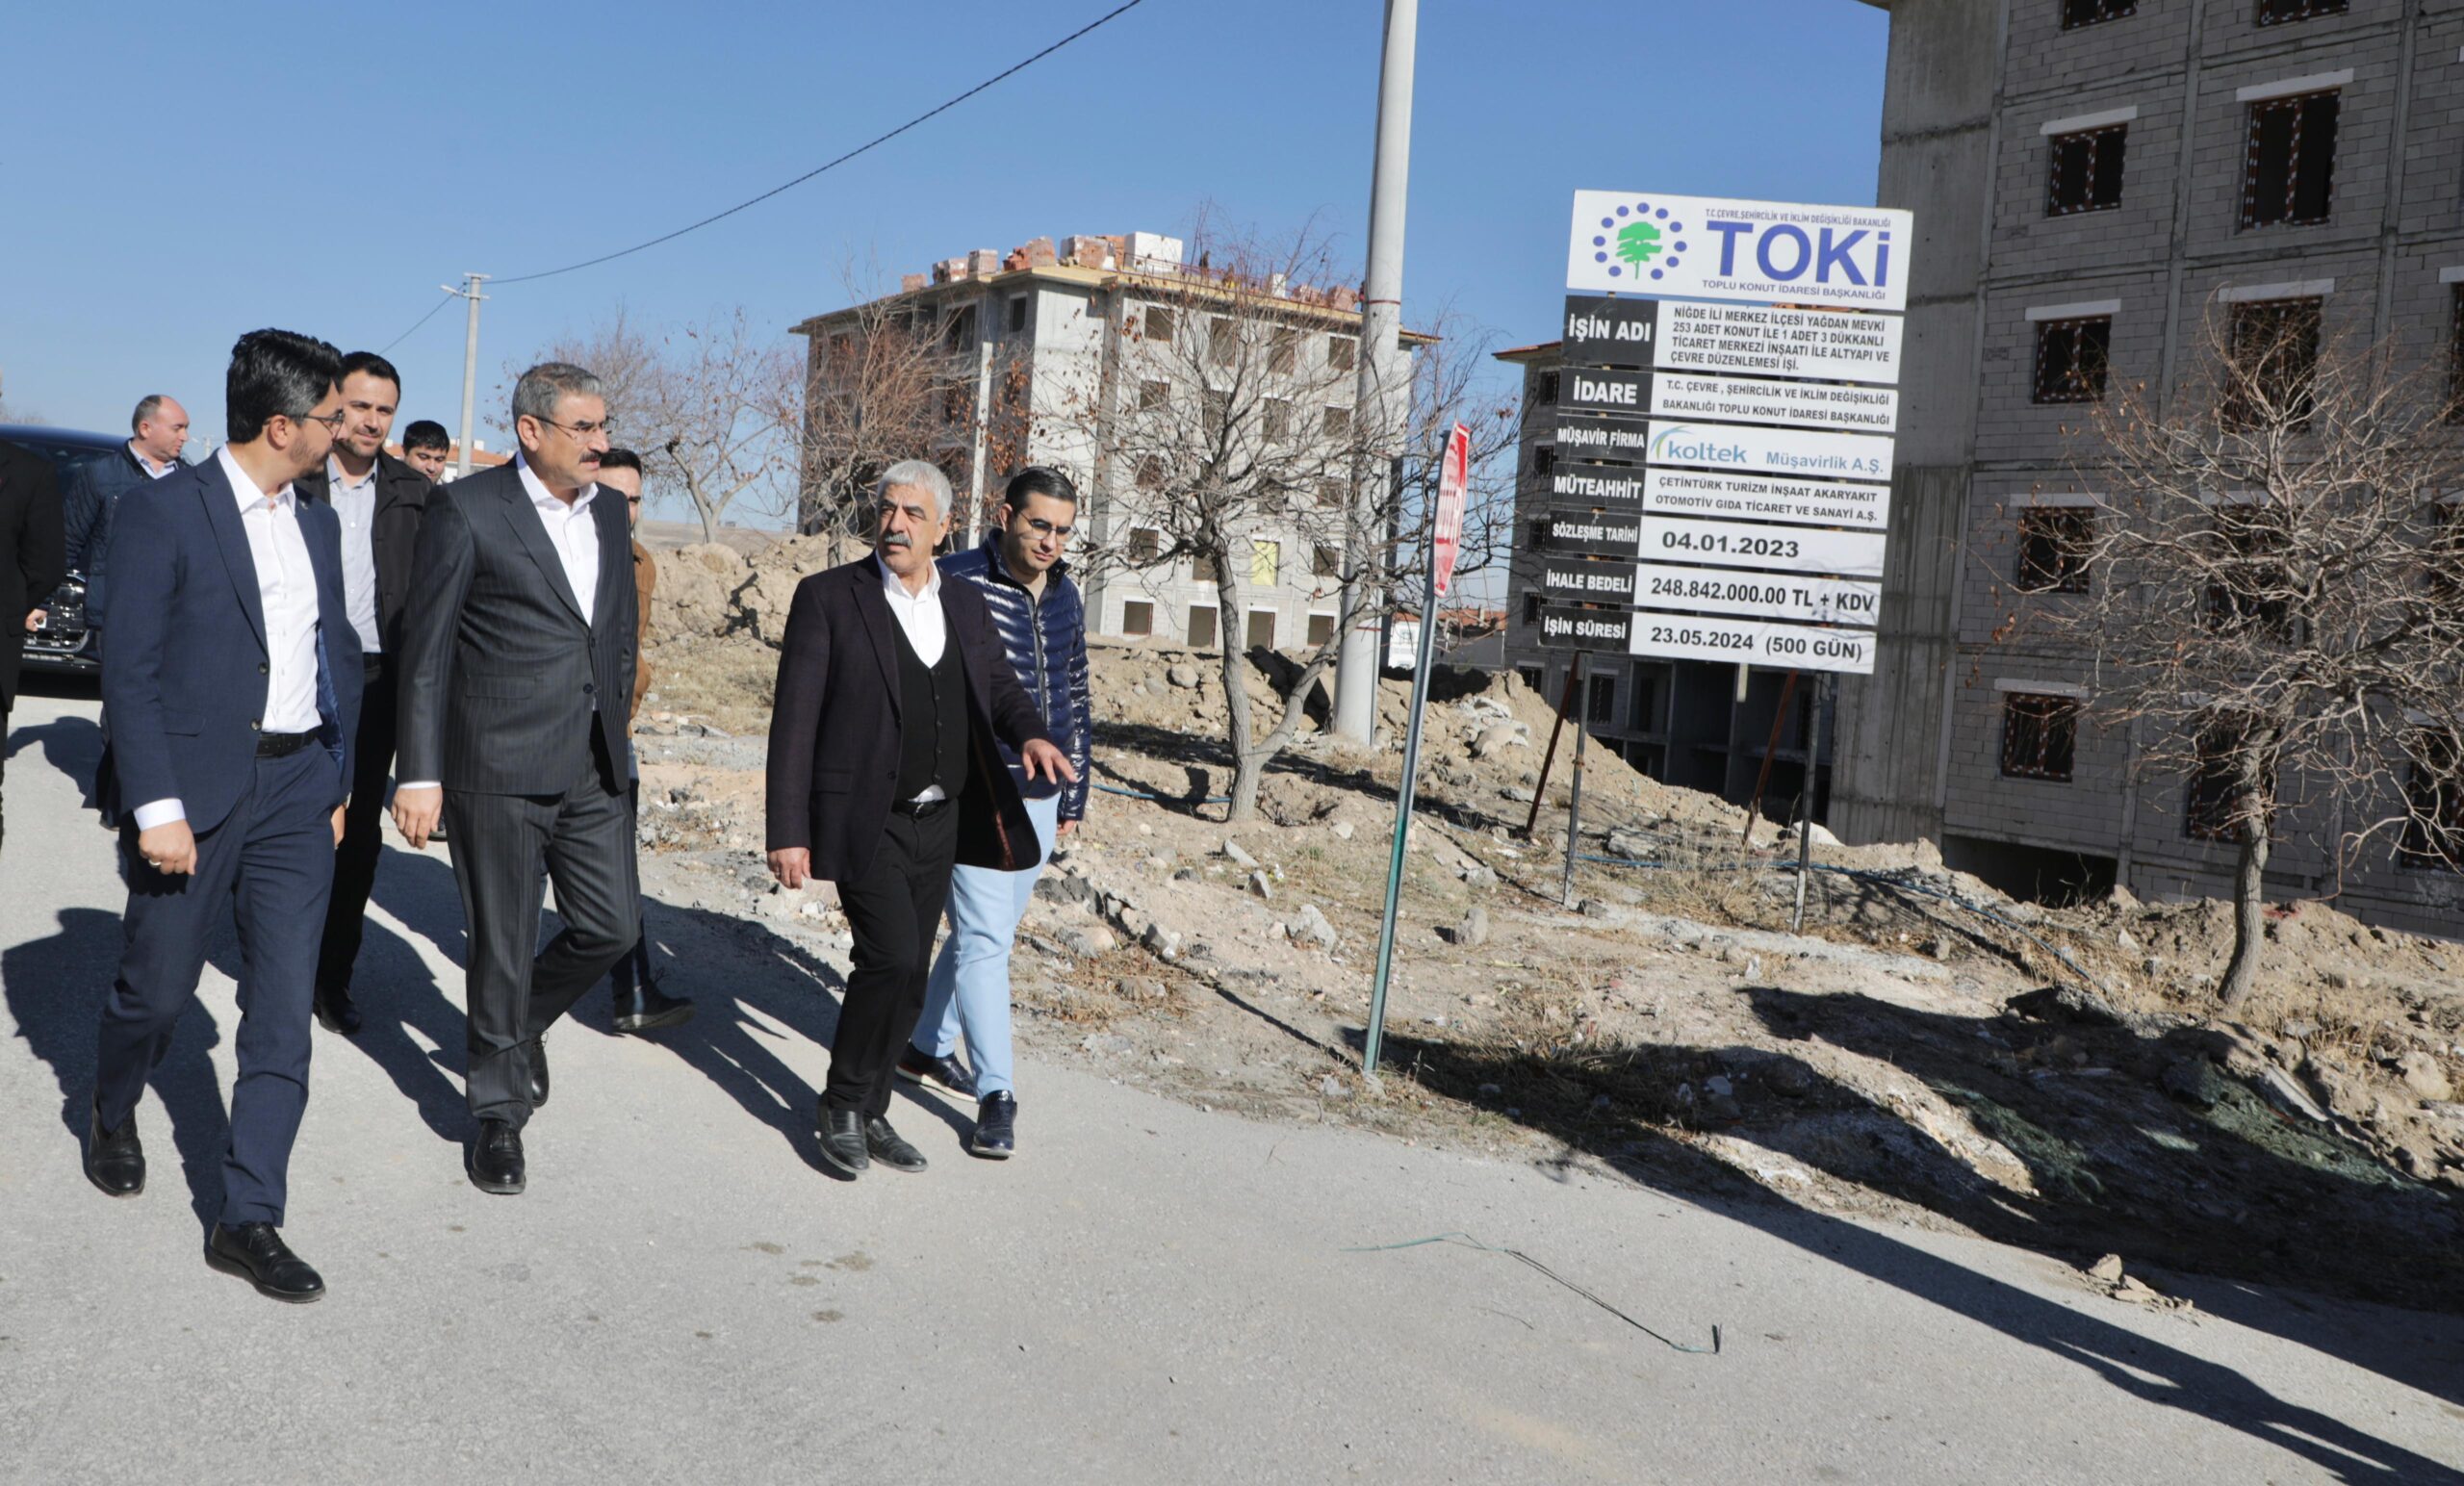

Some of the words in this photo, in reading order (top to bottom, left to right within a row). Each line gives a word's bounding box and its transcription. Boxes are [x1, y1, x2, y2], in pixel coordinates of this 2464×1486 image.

[1780, 213, 1789, 221] VE
[1790, 211, 1810, 222] İKLİM
[1853, 217, 1891, 227] BAKANLIĞI
[1702, 279, 1736, 289] TOPLU
[1739, 282, 1776, 293] KONUT
[1779, 283, 1820, 295] İDARESİ
[1822, 288, 1886, 300] BAŞKANLIĞI
[1569, 313, 1610, 343] İŞİN
[1615, 320, 1651, 342] ADI
[1674, 305, 1707, 320] NİĞDE
[1708, 307, 1722, 320] İLİ
[1725, 310, 1768, 323] MERKEZ
[1770, 311, 1804, 326] İLÇESİ
[1807, 315, 1849, 329] YAĞDAN
[1851, 318, 1886, 332] MEVKİ
[1673, 321, 1691, 333] 253
[1693, 322, 1721, 335] ADET
[1724, 325, 1760, 338] KONUT
[1762, 324, 1779, 340] İLE
[1783, 329, 1787, 340] 1
[1790, 330, 1818, 343] ADET
[1821, 332, 1827, 343] 3
[1830, 331, 1885, 346] DÜKKANLI
[1671, 350, 1705, 364] ÇEVRE
[1707, 351, 1780, 370] DÜZENLEMESİ
[1783, 356, 1799, 372] İŞİ.
[1672, 334, 1715, 349] TİCARET
[1718, 339, 1764, 353] MERKEZİ
[1767, 341, 1809, 357] İNŞAATI
[1810, 343, 1828, 358] İLE
[1830, 347, 1872, 361] ALTYAPI
[1875, 350, 1890, 362] VE
[1573, 375, 1637, 404] İDARE
[1667, 380, 1683, 391] T.C.
[1686, 381, 1718, 393] ÇEVRE
[1727, 383, 1782, 397] ŞEHİRCİLİK
[1784, 388, 1797, 398] VE
[1800, 387, 1828, 400] İKLİM
[1830, 391, 1889, 406] DEĞİŞİKLİĞİ
[1663, 399, 1715, 412] BAKANLIĞI
[1718, 403, 1750, 415] TOPLU
[1752, 405, 1786, 417] KONUT
[1789, 406, 1828, 421] İDARESİ
[1830, 411, 1889, 425] BAŞKANLIĞI
[1557, 425, 1607, 448] MÜŞAVİR
[1609, 428, 1645, 448] FİRMA
[1668, 440, 1748, 463] koltek
[1766, 450, 1847, 470] Müşavirlik
[1851, 457, 1884, 474] A.Ş.
[1553, 474, 1642, 500] MÜTEAHHİT
[1659, 476, 1722, 491] ÇETİNTÜRK
[1726, 480, 1768, 494] TURİZM
[1771, 483, 1810, 497] İNŞAAT
[1813, 489, 1877, 502] AKARYAKIT
[1656, 494, 1712, 508] OTOMOTİV
[1716, 500, 1742, 510] GIDA
[1745, 500, 1792, 515] TİCARET
[1795, 505, 1810, 515] VE
[1813, 506, 1853, 519] SANAYİ
[1856, 510, 1877, 523] A.Ş.
[1552, 522, 1604, 543] SÖZLEŞME
[1605, 525, 1638, 543] TARİHİ
[1662, 531, 1799, 558] 04.01.2023
[1546, 569, 1584, 589] İHALE
[1587, 575, 1632, 594] BEDELİ
[1651, 577, 1786, 604] 248.842.000.00
[1792, 589, 1813, 607] TL
[1820, 594, 1830, 606] +
[1835, 593, 1875, 612] KDV
[1544, 615, 1573, 637] İŞİN
[1576, 620, 1627, 639] SÜRESİ
[1651, 627, 1754, 651] 23.05.2024
[1766, 635, 1807, 656] (500
[1812, 638, 1861, 663] GÜN)
